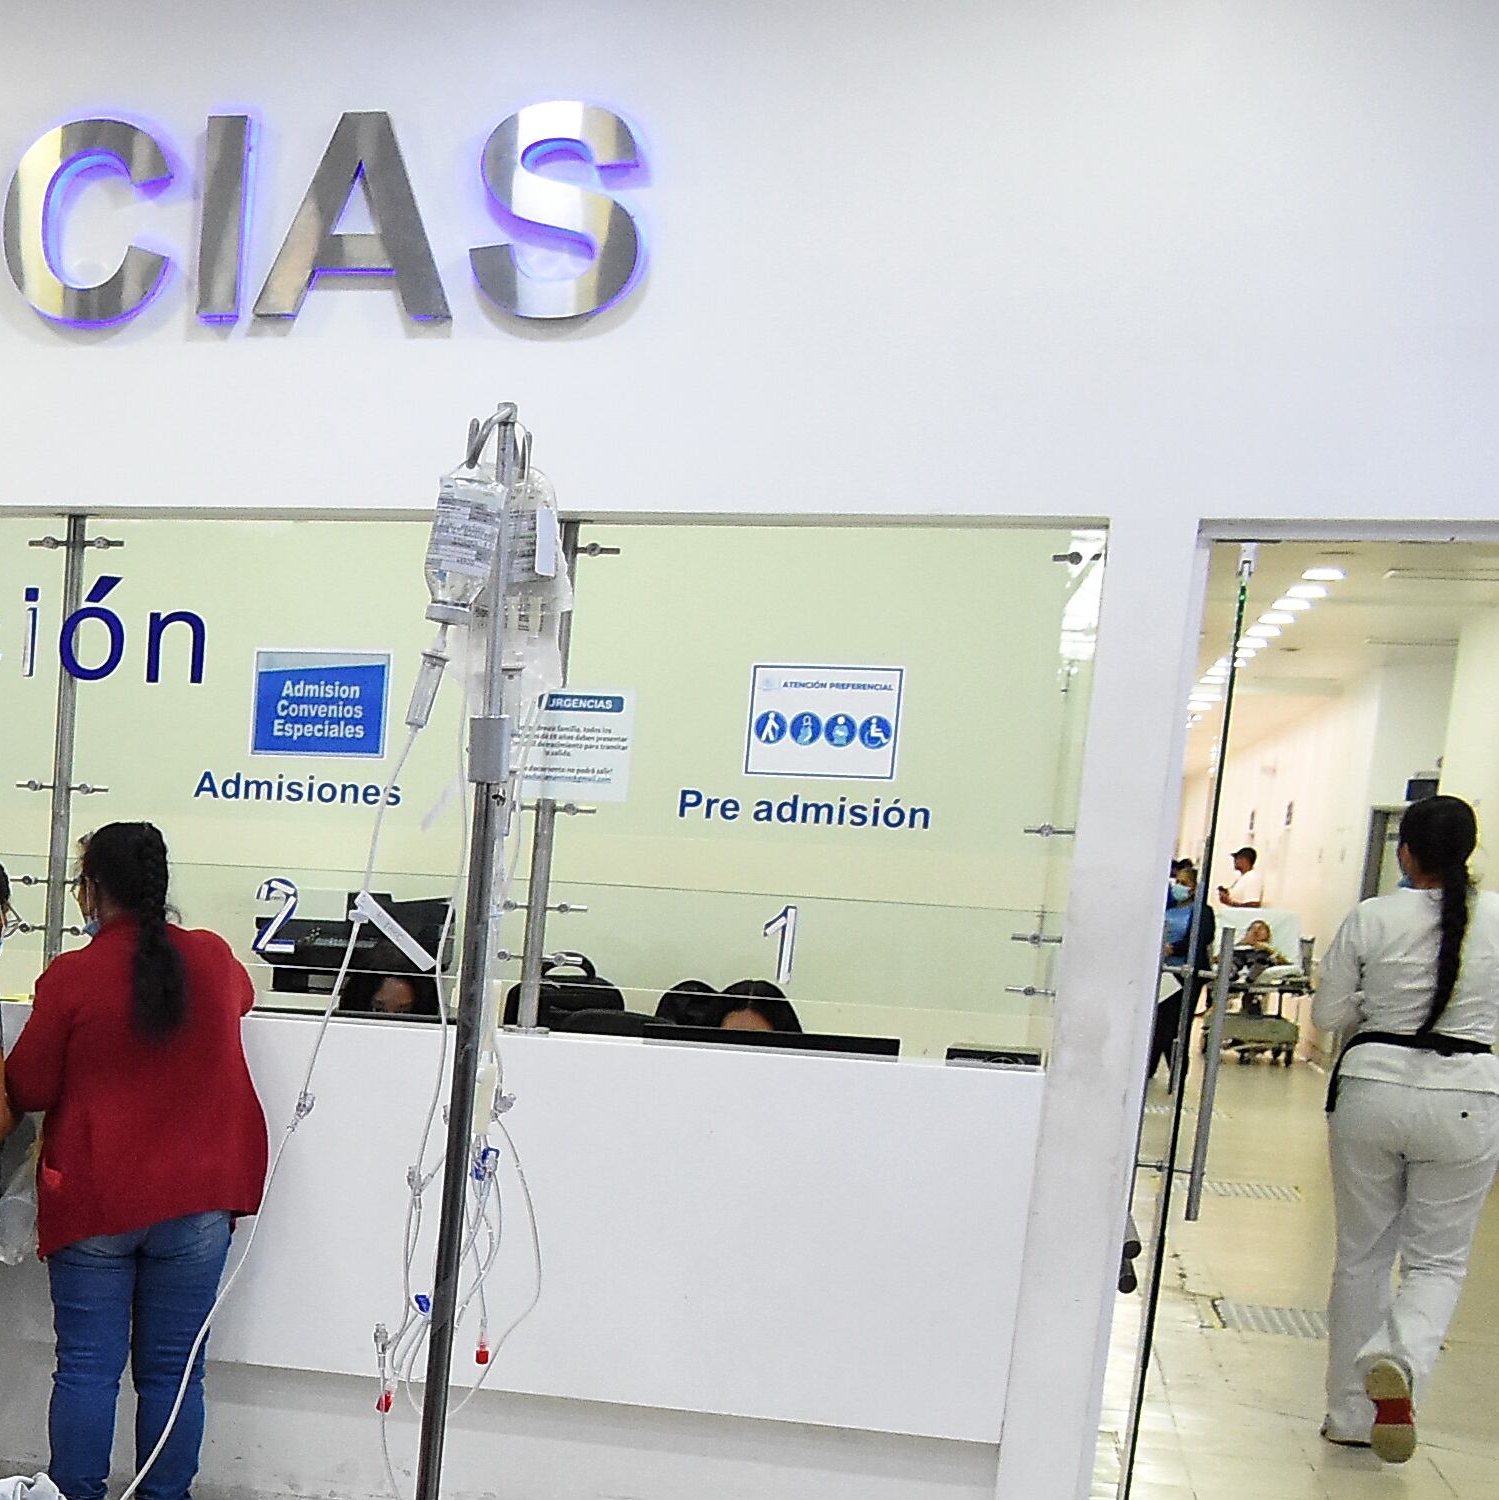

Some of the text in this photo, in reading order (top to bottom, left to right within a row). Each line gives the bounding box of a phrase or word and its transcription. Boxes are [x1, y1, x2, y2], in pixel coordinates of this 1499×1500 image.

[281, 680, 360, 700] Admision
[782, 680, 894, 691] ATENCIÓN PREFERENCIAL
[276, 700, 363, 720] Convenios
[272, 719, 365, 741] Especiales
[193, 771, 402, 807] Admisiones
[677, 789, 931, 830] Pre admisión
[253, 877, 297, 955] 2
[762, 904, 798, 985] 1
